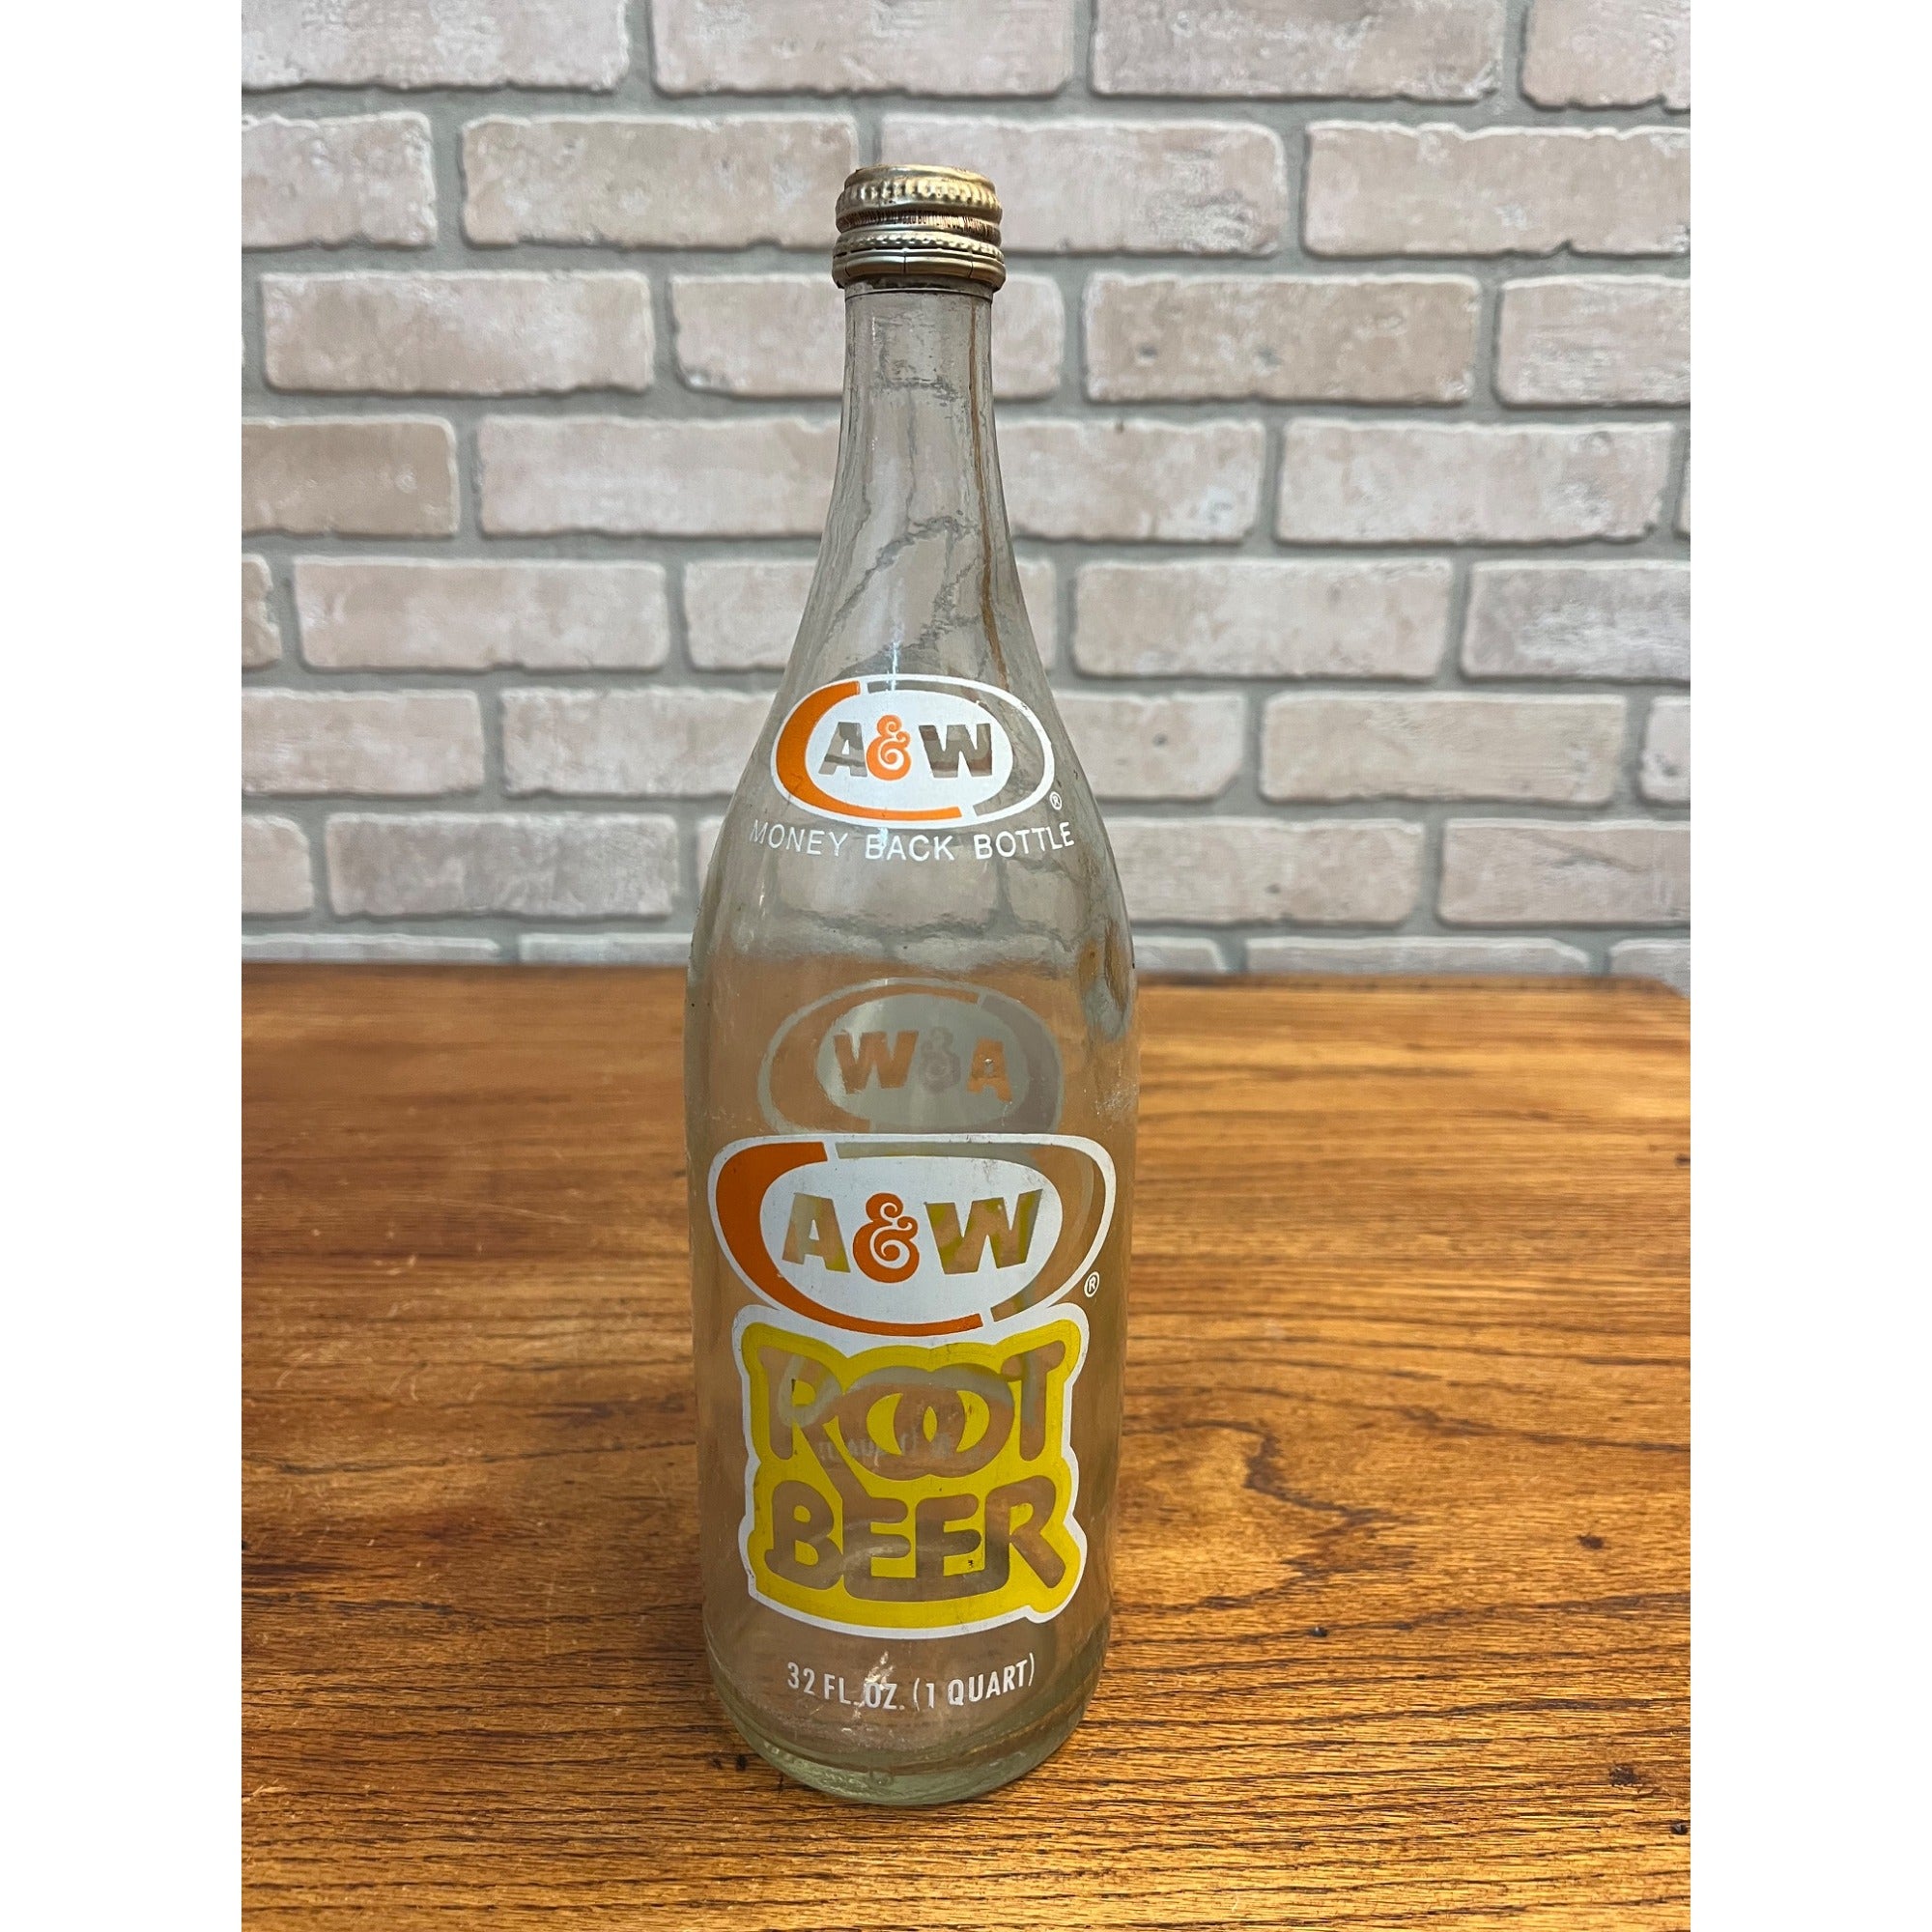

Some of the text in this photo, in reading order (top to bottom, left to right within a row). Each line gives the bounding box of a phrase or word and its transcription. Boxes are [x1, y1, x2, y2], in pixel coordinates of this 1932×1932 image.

[818, 715, 993, 781] A&W
[750, 819, 1075, 862] MONEY BACK BOTTLE
[781, 1188, 1043, 1283] A&W
[759, 1340, 1066, 1482] ROOT
[764, 1474, 1066, 1603] BEER
[786, 1661, 817, 1696] 32
[863, 1681, 905, 1710] OZ.
[912, 1676, 936, 1712] (1
[947, 1652, 1035, 1707] QUART)
